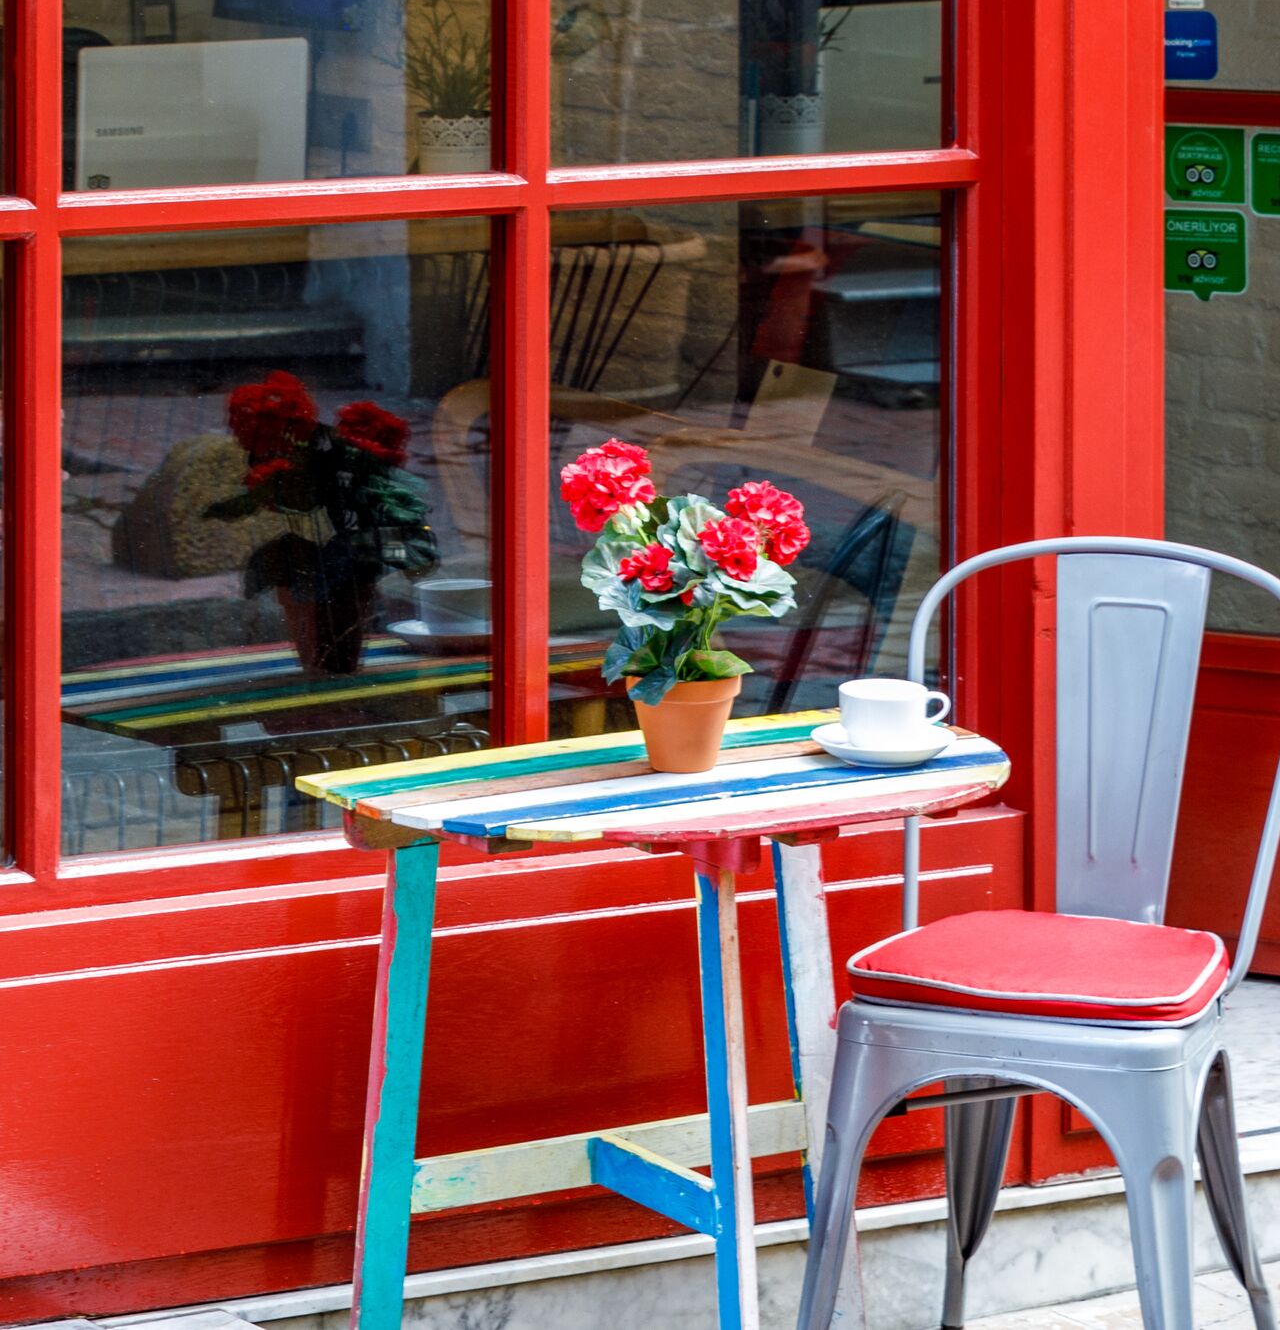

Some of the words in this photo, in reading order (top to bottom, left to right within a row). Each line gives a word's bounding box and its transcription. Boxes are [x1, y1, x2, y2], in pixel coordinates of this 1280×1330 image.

[1164, 38, 1211, 48] ooking.com
[95, 126, 144, 137] SAMSUNG
[1167, 219, 1237, 233] ÖNERİLİYOR
